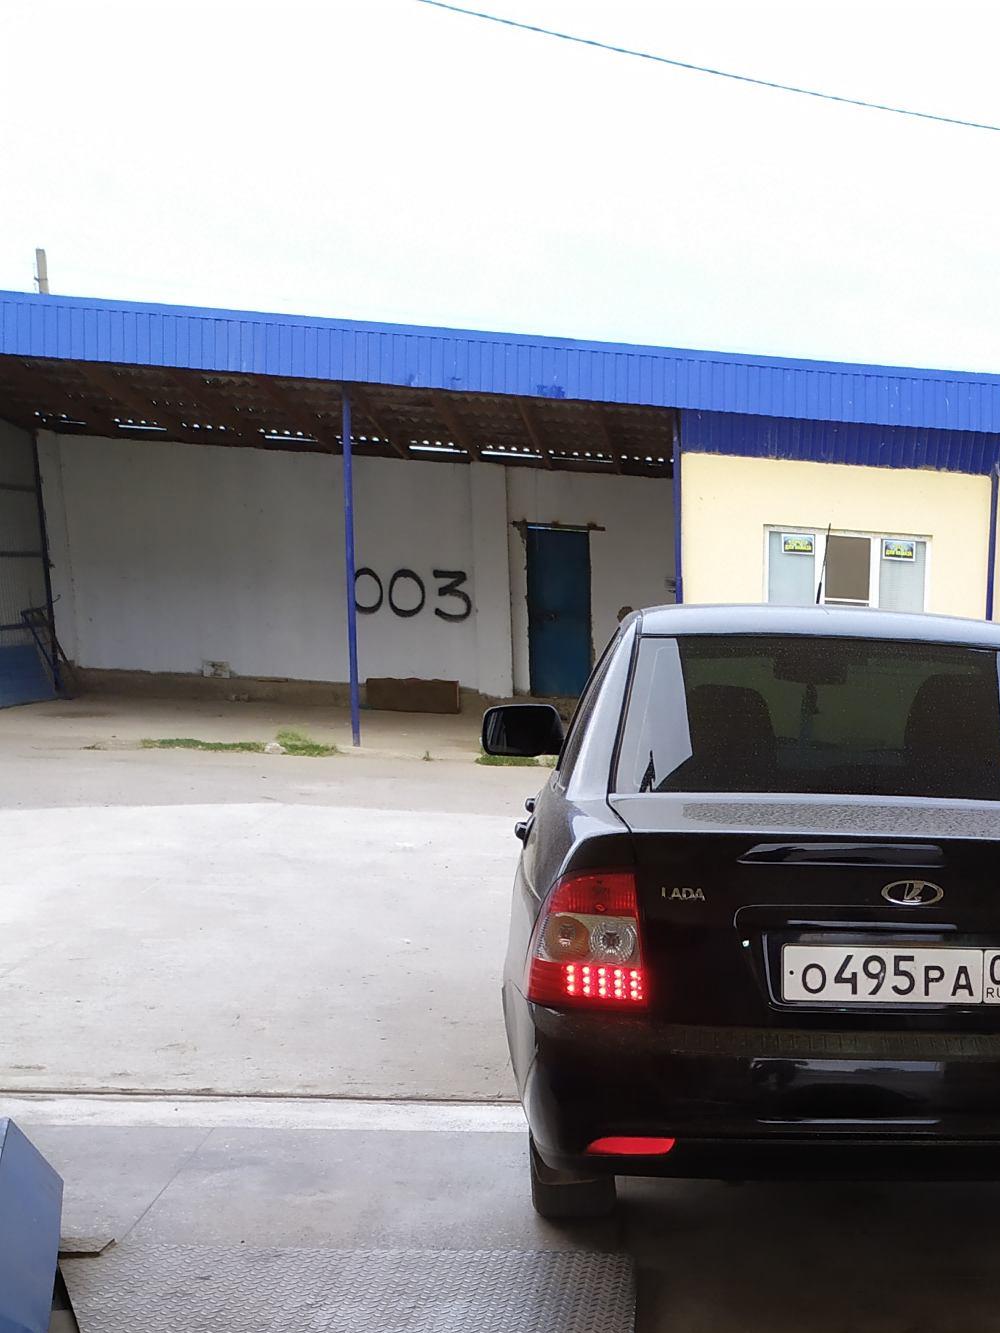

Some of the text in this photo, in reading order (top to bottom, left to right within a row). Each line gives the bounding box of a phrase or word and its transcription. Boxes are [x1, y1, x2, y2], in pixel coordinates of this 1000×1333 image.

[354, 567, 472, 622] 003
[661, 887, 706, 902] LADA
[801, 954, 975, 997] О495РА
